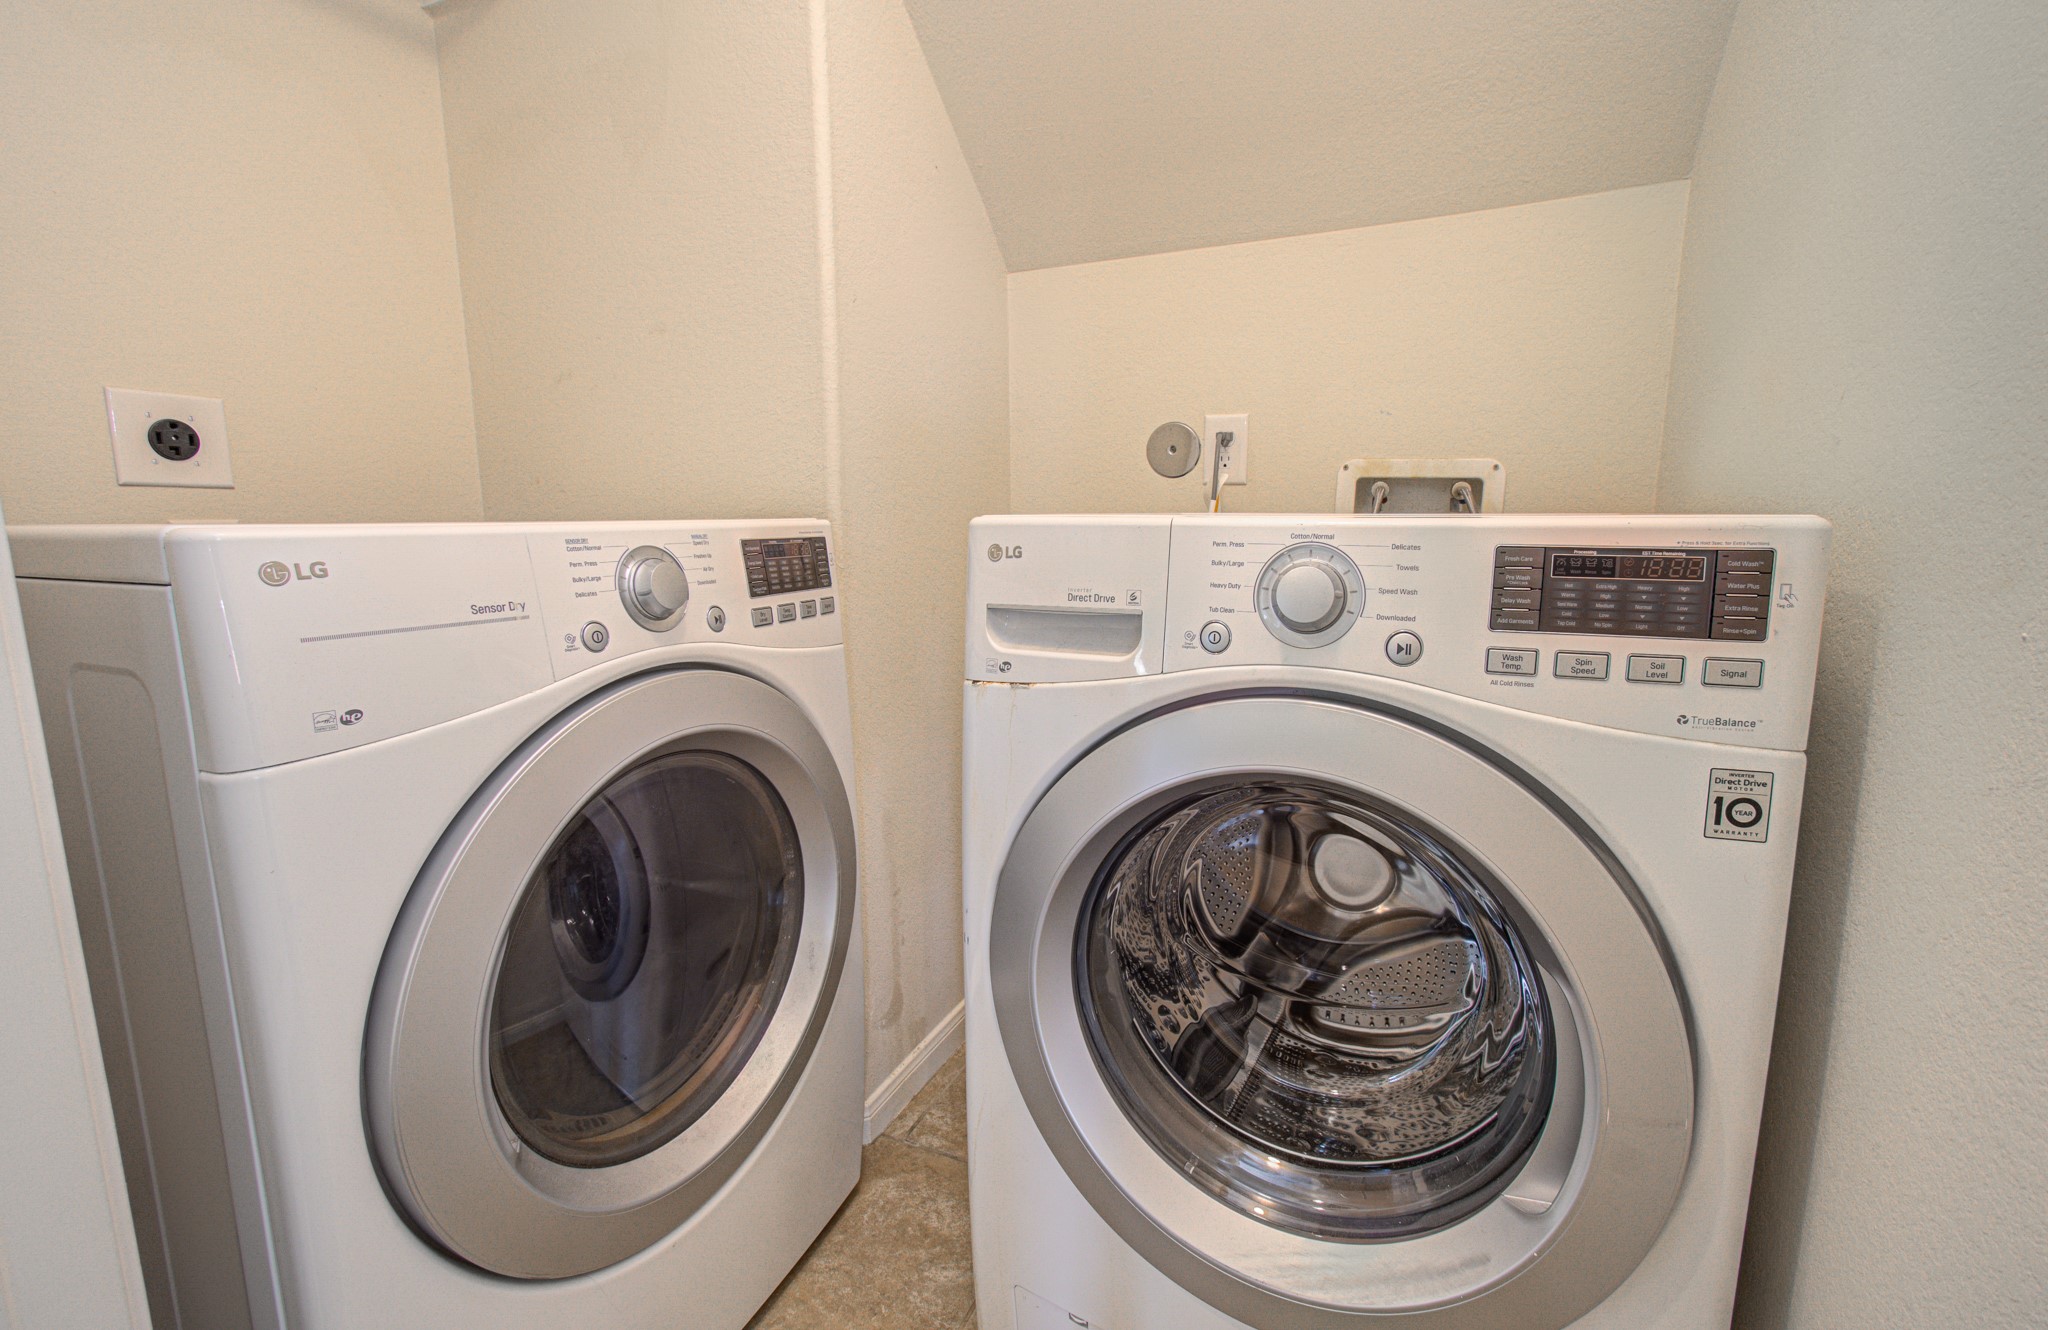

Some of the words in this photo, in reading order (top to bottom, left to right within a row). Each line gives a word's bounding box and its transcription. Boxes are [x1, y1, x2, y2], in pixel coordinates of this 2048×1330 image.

[1391, 543, 1421, 551] Delicates
[1005, 545, 1023, 559] LG
[1211, 560, 1245, 568] Bulky/Large
[1396, 564, 1420, 572] Towels
[293, 561, 329, 581] LG
[1209, 582, 1227, 590] Heavy
[1378, 588, 1398, 596] Speed
[1067, 592, 1092, 603] Direct
[1093, 593, 1116, 604] Drive
[1500, 597, 1515, 605] Delay
[470, 603, 506, 615] Sensor
[1376, 613, 1416, 622] Downloaded
[1502, 653, 1524, 662] Wash
[1500, 661, 1524, 670] Temp.
[1575, 658, 1593, 667] Spin
[1650, 661, 1666, 670] Soil
[1570, 666, 1596, 675] Speed
[1645, 670, 1668, 679] Level
[1720, 669, 1748, 678] Signal
[1714, 777, 1742, 786] Direct
[1743, 779, 1768, 787] Drive
[1713, 796, 1763, 828] 10
[1734, 809, 1753, 817] YEAR
[1713, 829, 1759, 837] WARRANTY
